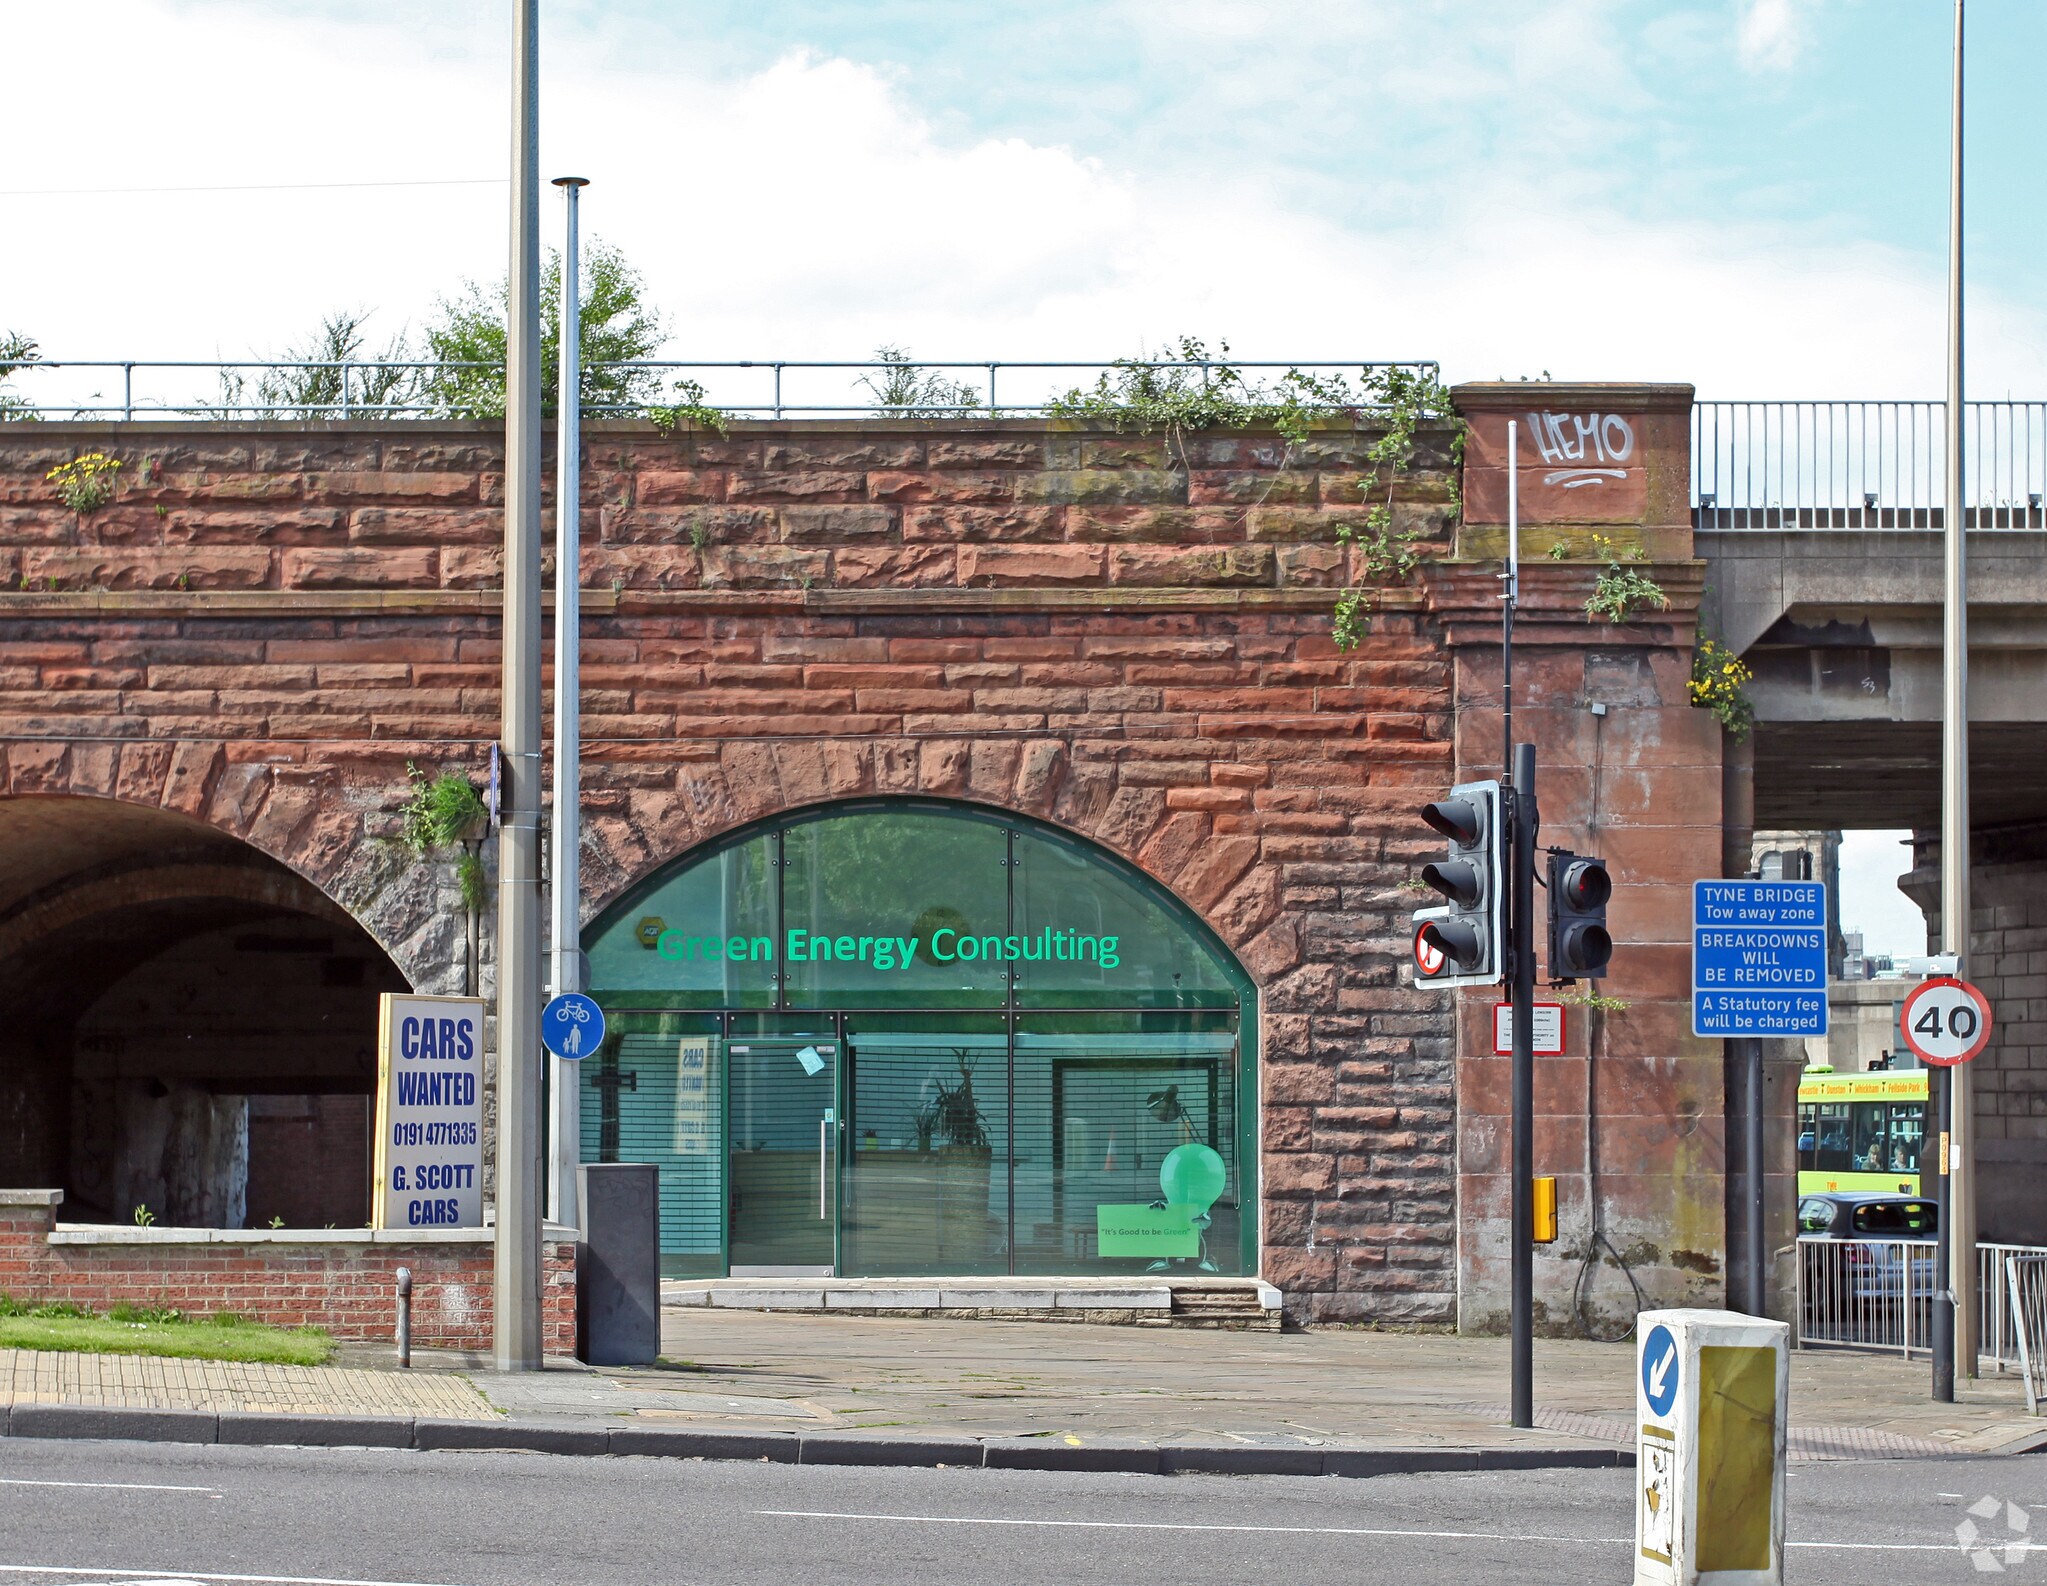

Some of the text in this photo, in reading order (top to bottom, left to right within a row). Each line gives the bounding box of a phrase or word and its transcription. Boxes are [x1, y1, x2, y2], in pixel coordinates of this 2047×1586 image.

[1704, 888, 1816, 903] TYNE BRIDGE
[1704, 905, 1815, 922] Tow away zone
[657, 926, 1120, 970] Green Energy Consulting
[1702, 933, 1819, 948] BREAKDOWNS
[1743, 951, 1780, 965] WILL
[1705, 968, 1816, 982] BE REMOVED
[1702, 996, 1819, 1014] A Statutory fee
[1703, 1014, 1818, 1031] will be charged
[1914, 1005, 1977, 1039] 40
[401, 1016, 474, 1060] CARS
[398, 1072, 475, 1106] WANTED
[394, 1122, 477, 1146] 0191 4771335
[393, 1164, 475, 1191] G. SCOTT
[408, 1198, 459, 1226] CARS
[1118, 1228, 1140, 1236] Good
[1151, 1228, 1162, 1236] be
